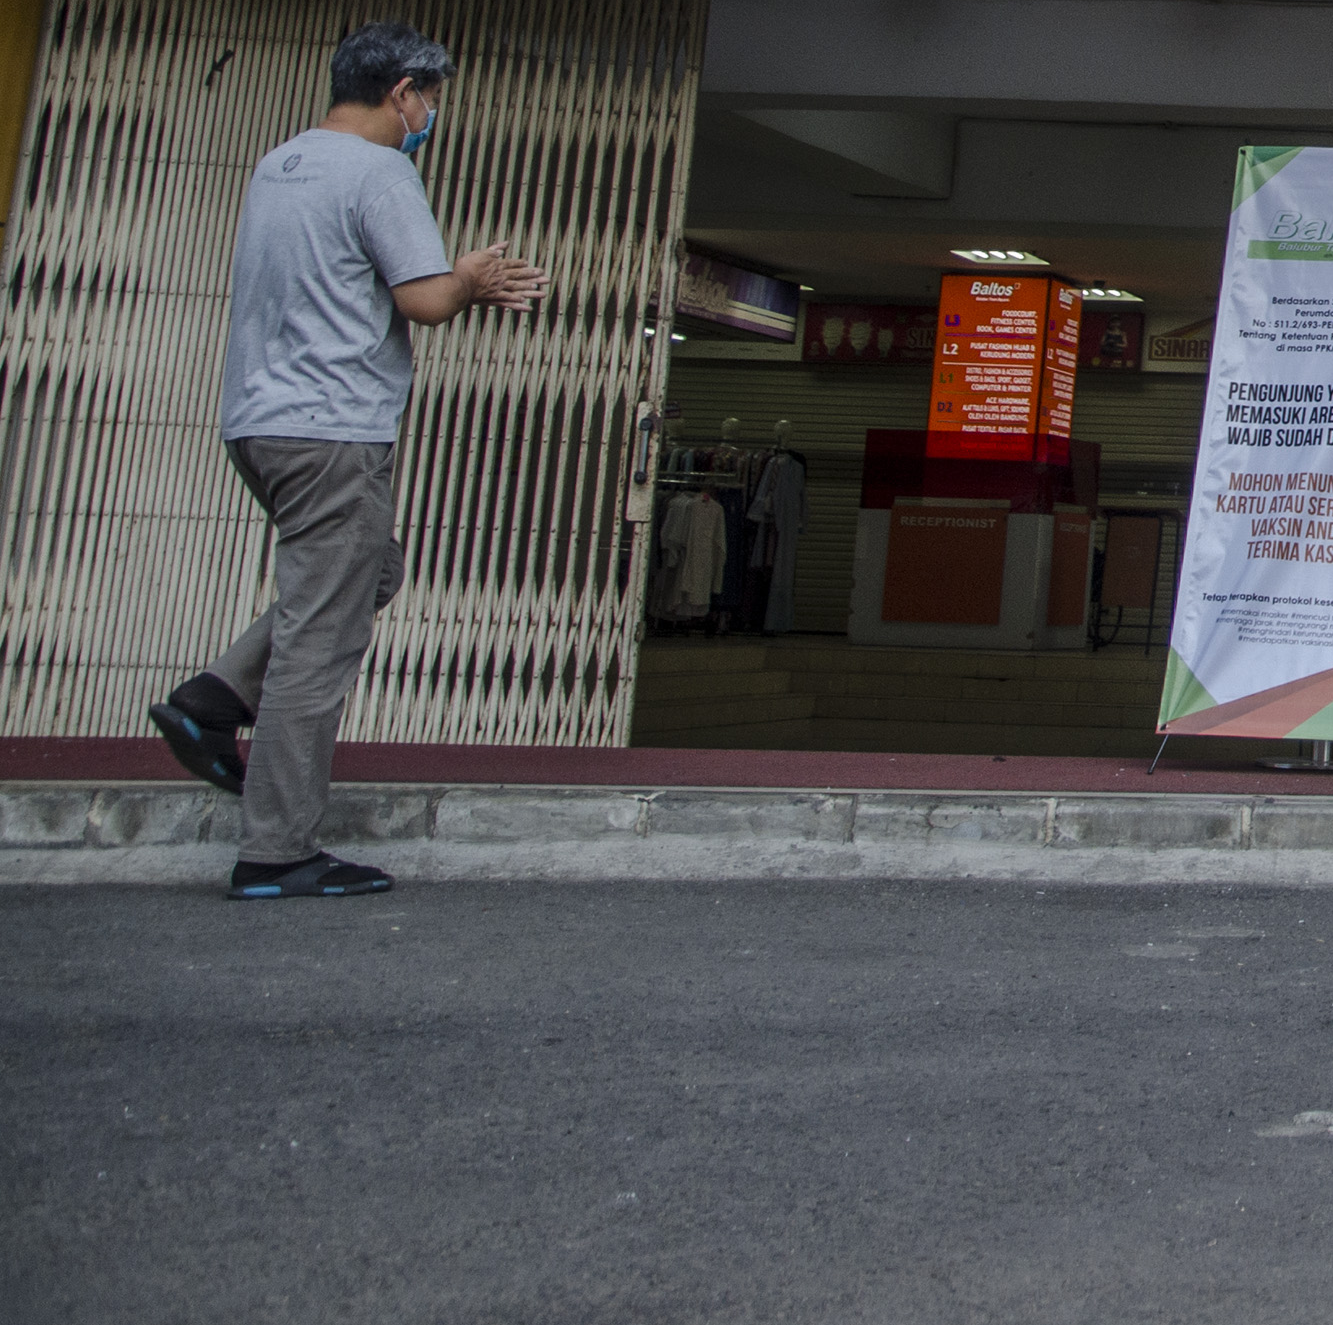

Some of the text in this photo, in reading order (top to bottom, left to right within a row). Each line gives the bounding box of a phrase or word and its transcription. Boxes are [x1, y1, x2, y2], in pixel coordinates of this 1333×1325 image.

[1277, 242, 1323, 252] Balubur
[970, 281, 1014, 296] Baltos
[1272, 296, 1330, 306] Berdasarkan
[1252, 319, 1266, 328] No
[1238, 329, 1277, 342] Tentang
[1282, 332, 1329, 341] Ketentuan
[942, 343, 959, 355] L2
[1276, 343, 1285, 352] di
[1228, 382, 1324, 403] PENGUNJUNG
[1225, 404, 1306, 425] MEMASUKI
[1227, 426, 1272, 447] WAJIB
[1275, 427, 1323, 447] SUDAH
[1228, 472, 1284, 492] MOHON
[1215, 494, 1266, 514] KARTU
[1268, 495, 1305, 514] ATAU
[900, 516, 997, 529] RECEPTIONIST
[1251, 517, 1303, 537] VAKSIN
[1247, 540, 1300, 562] TERIMA
[1202, 592, 1228, 603] Tetap
[1229, 592, 1271, 603] terapkan
[1272, 596, 1312, 606] protokol
